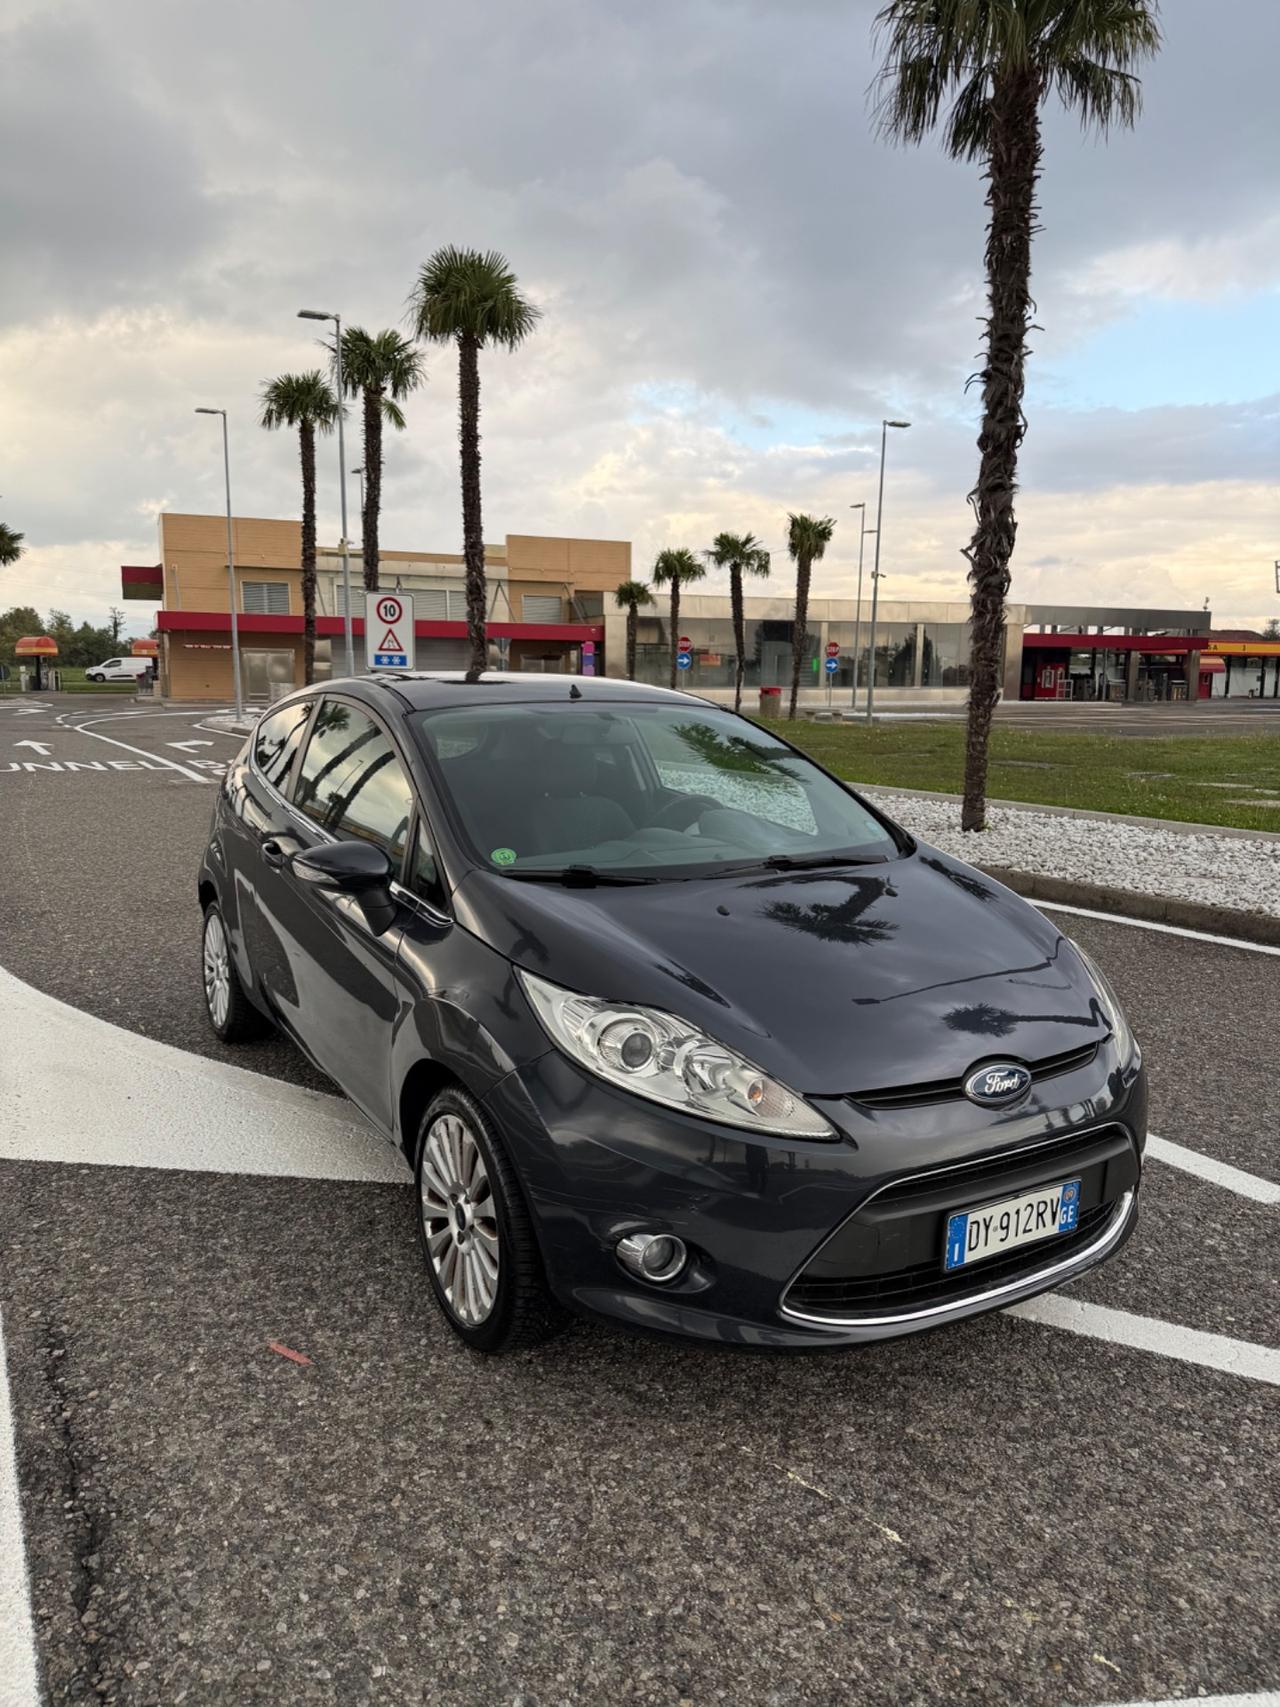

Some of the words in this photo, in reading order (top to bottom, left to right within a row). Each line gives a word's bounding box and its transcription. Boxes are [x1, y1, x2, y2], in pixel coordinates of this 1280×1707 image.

[383, 604, 396, 617] 10
[984, 1071, 1019, 1094] Ford
[999, 1197, 1060, 1243] 912RV
[1060, 1205, 1074, 1224] GE
